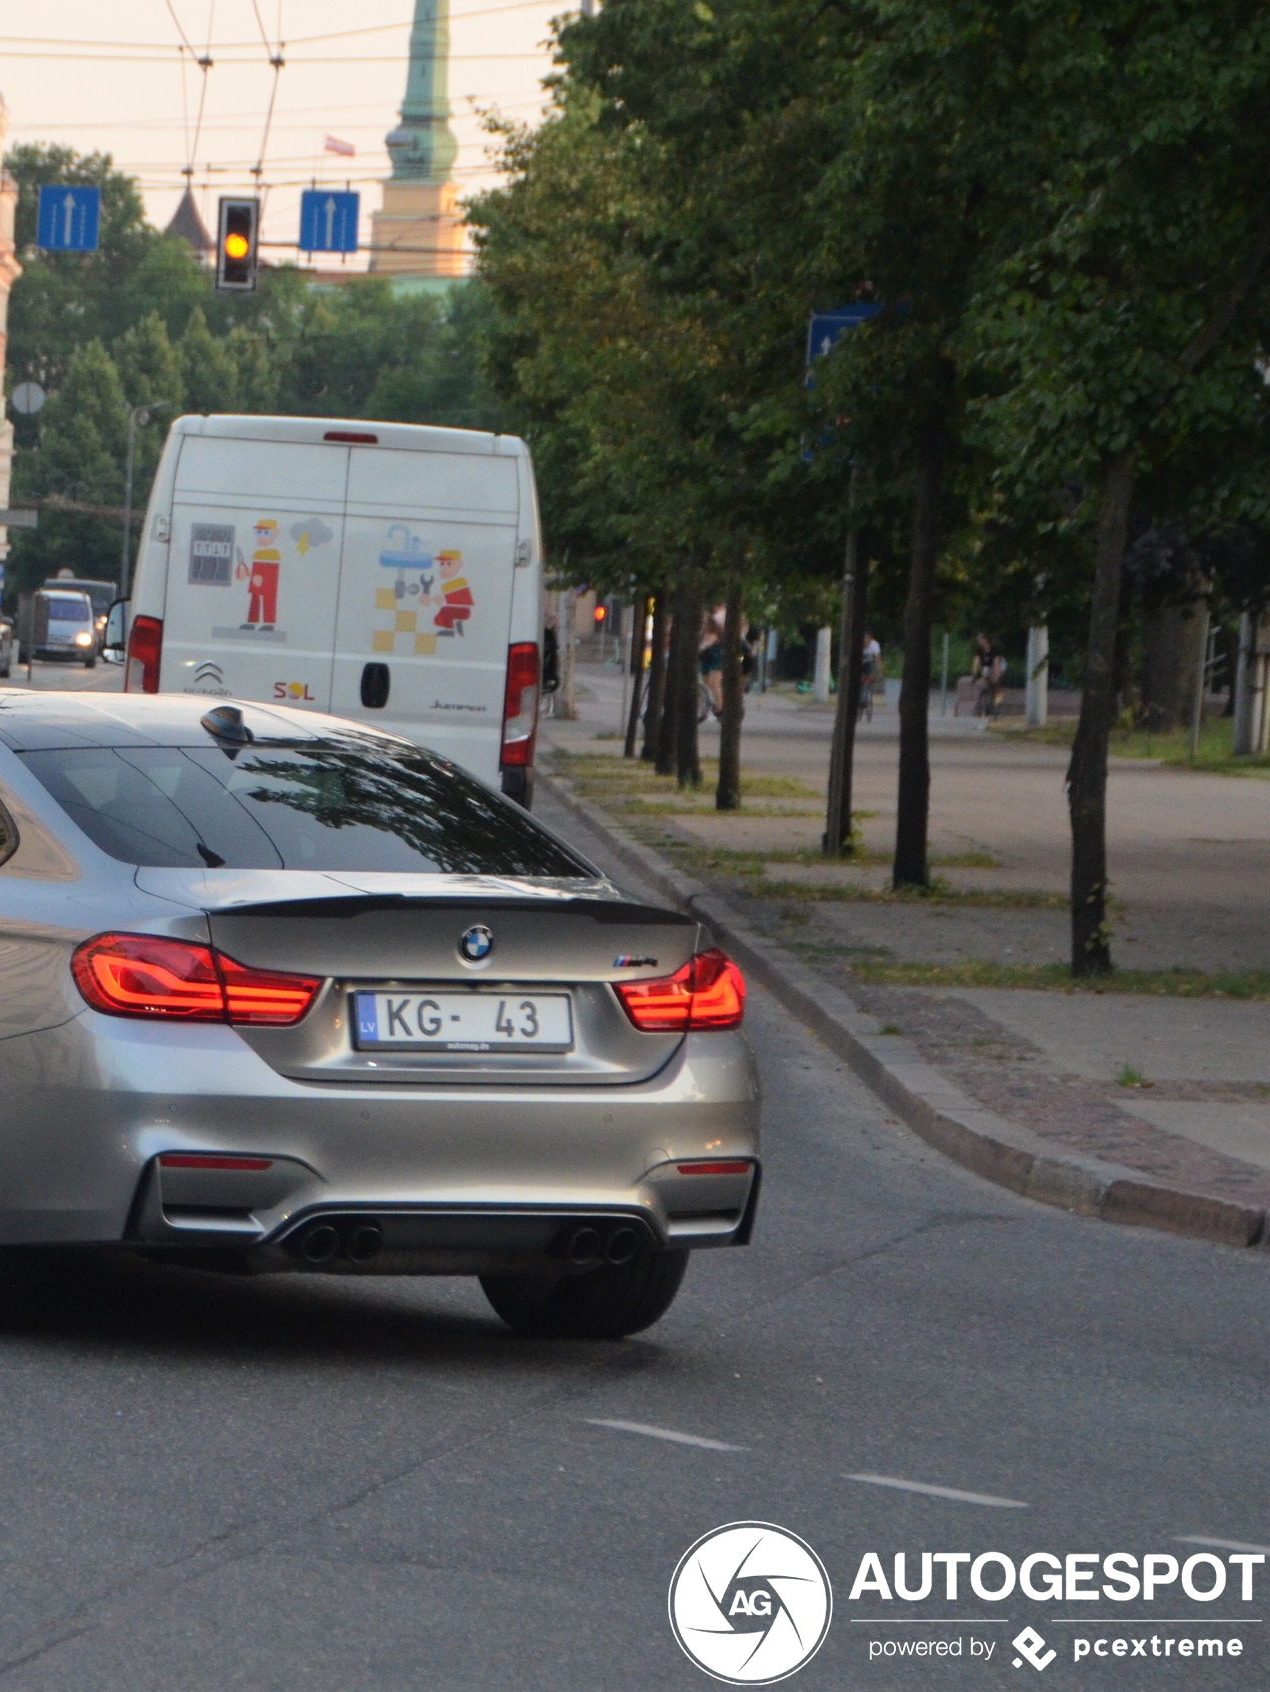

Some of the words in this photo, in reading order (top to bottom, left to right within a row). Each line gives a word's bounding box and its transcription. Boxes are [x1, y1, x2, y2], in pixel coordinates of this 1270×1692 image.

[274, 682, 316, 701] SOL
[360, 1022, 376, 1033] LV
[495, 1000, 540, 1038] 43
